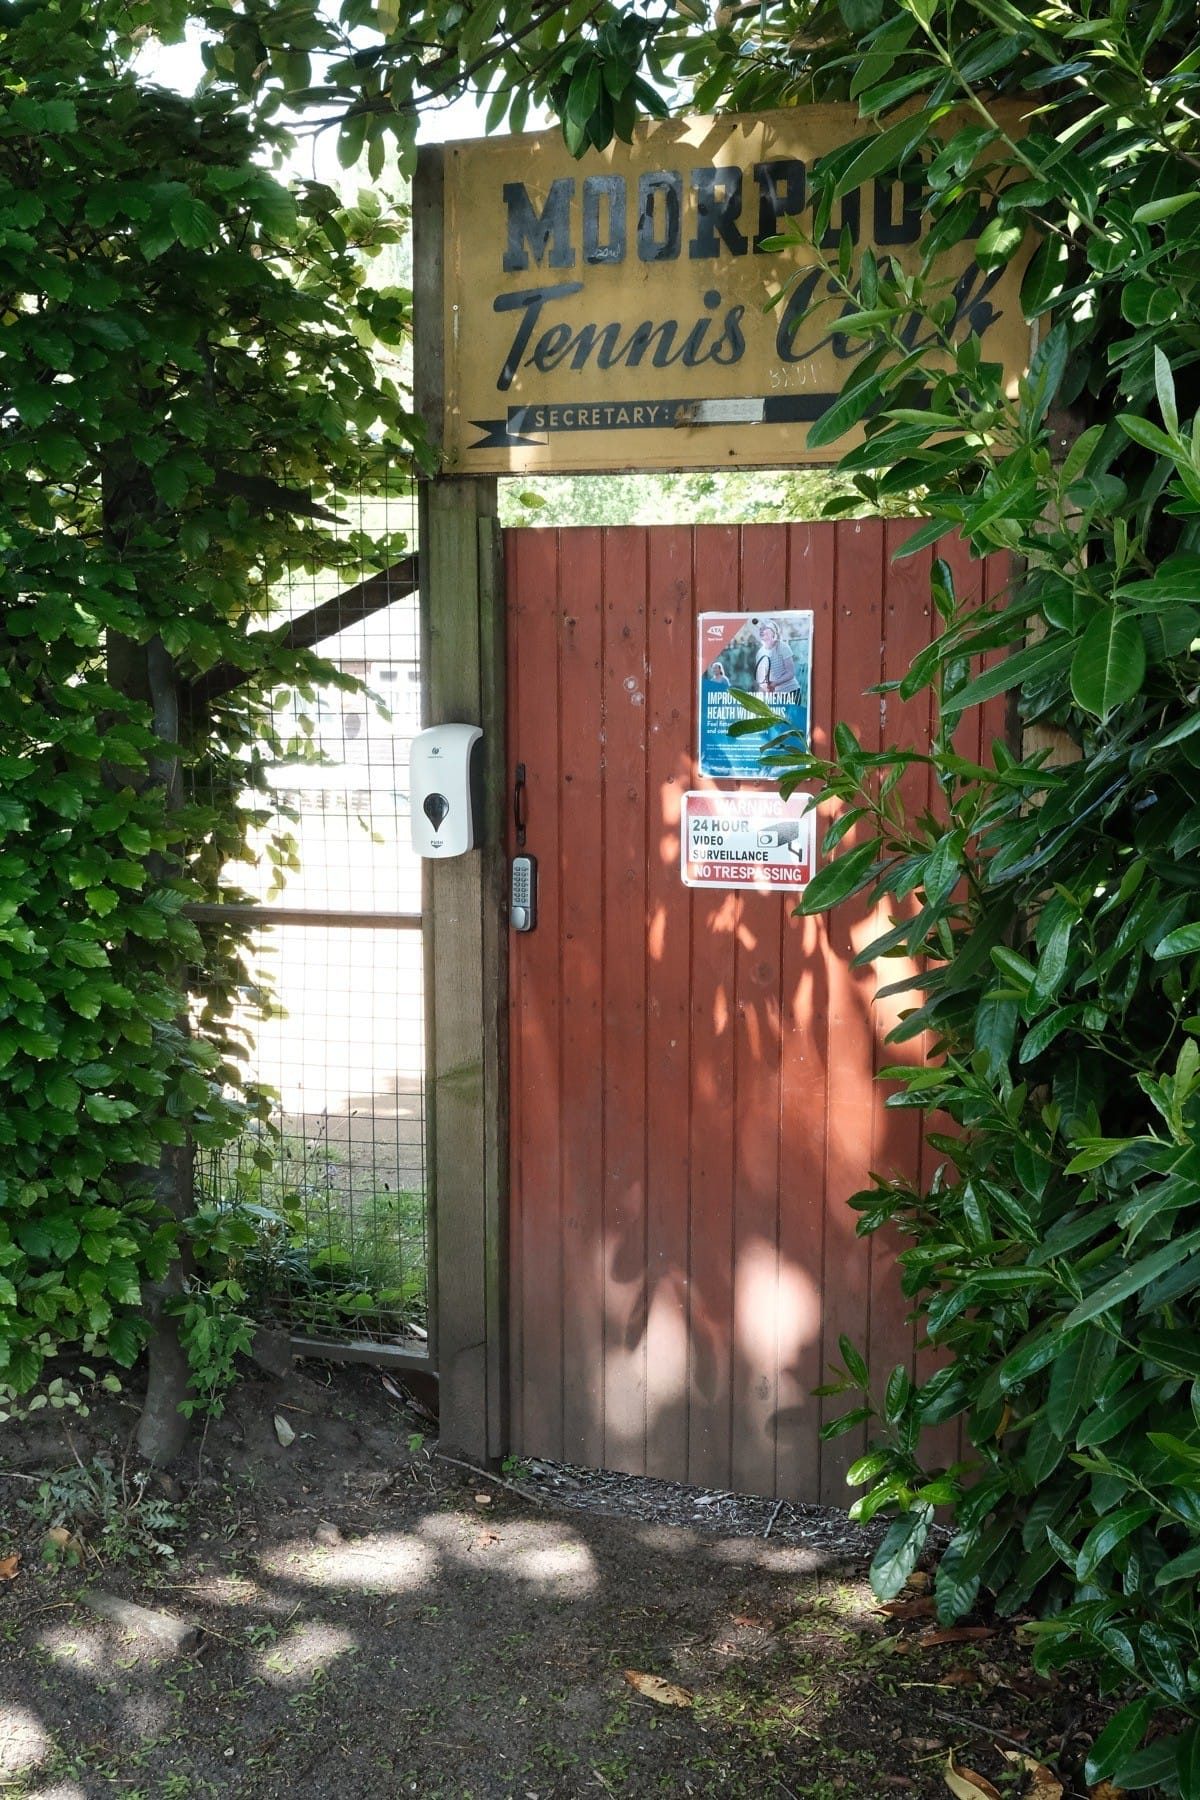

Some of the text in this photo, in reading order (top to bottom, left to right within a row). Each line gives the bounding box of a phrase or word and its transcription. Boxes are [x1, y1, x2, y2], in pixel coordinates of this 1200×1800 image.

[493, 282, 746, 392] Tennis
[535, 406, 670, 428] SECRETARY:
[765, 691, 796, 705] MENTAL
[707, 706, 735, 720] HEALTH
[693, 819, 750, 833] 24 HOUR
[693, 835, 724, 846] VIDEO
[693, 849, 769, 862] SURVEILLANCE
[695, 864, 802, 881] NO TRESPASSING
